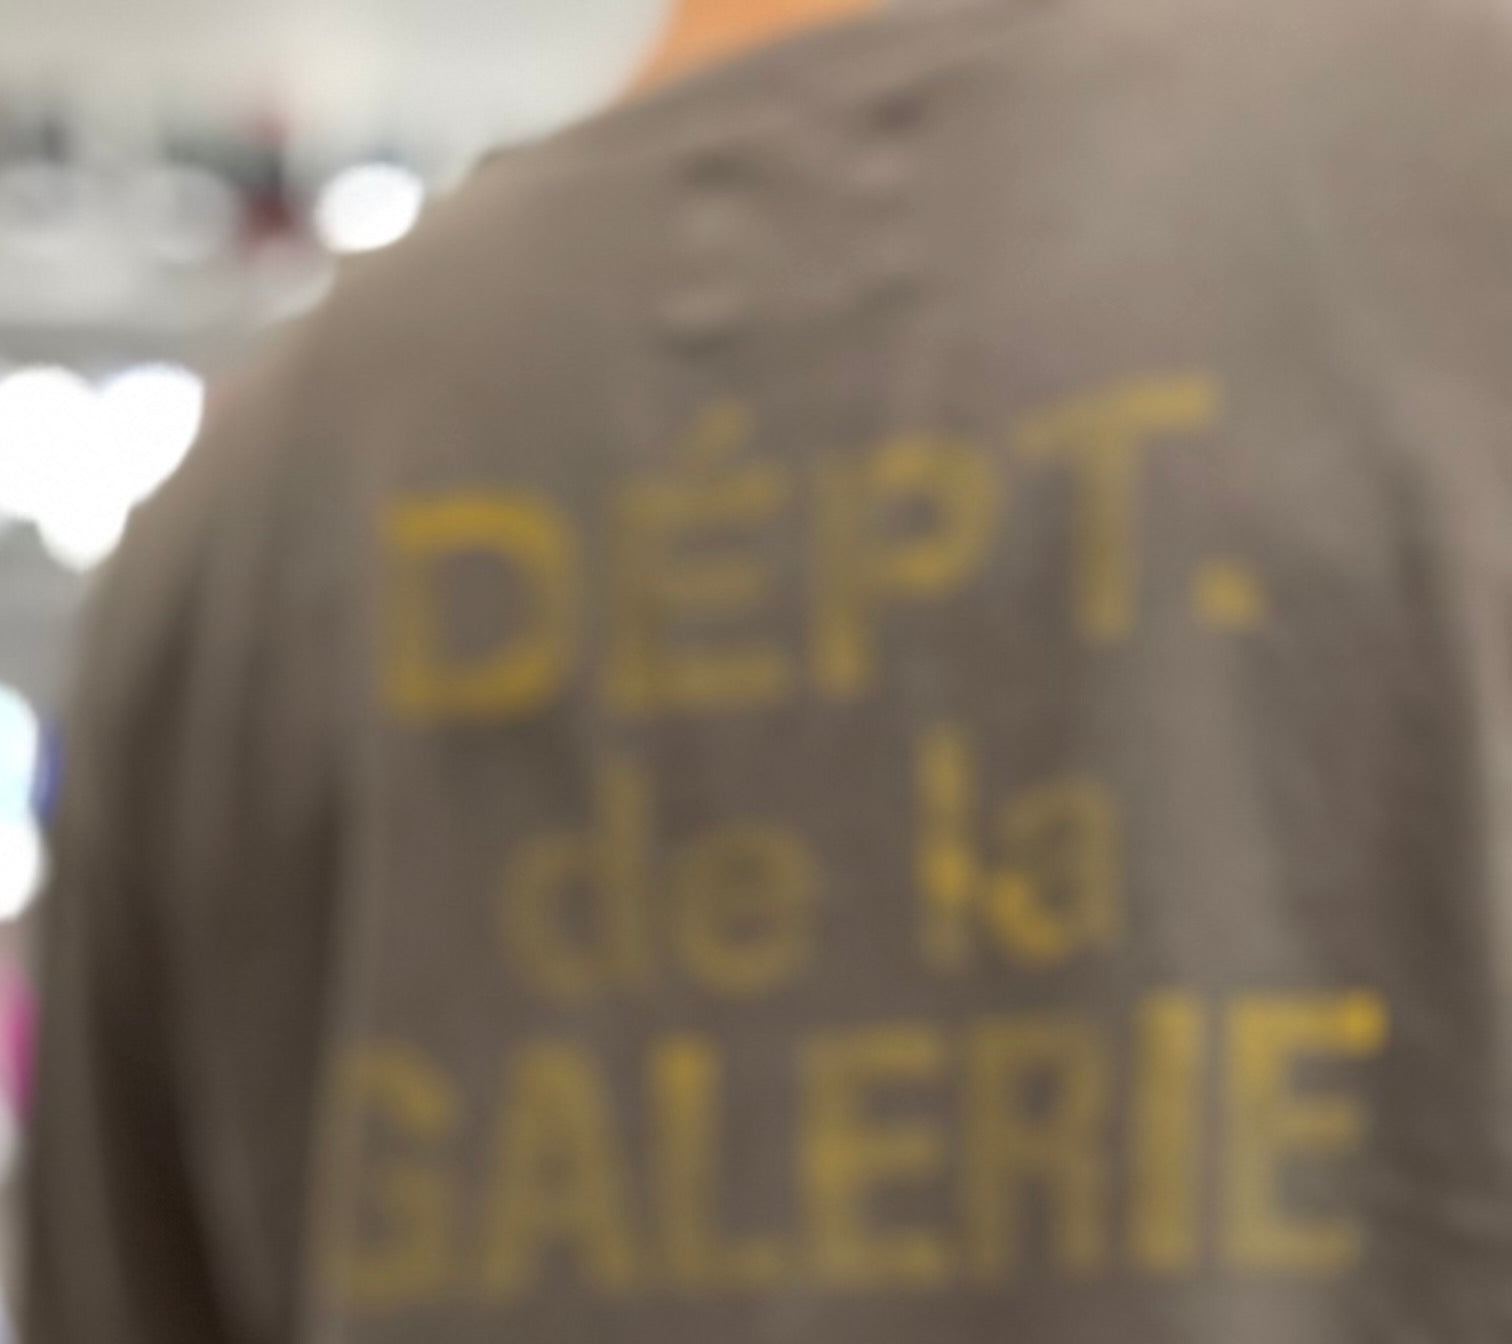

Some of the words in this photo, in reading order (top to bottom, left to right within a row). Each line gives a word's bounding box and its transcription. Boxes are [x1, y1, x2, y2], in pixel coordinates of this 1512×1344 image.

[380, 374, 1264, 724] DÉPT.
[501, 750, 820, 1000] de
[915, 722, 1122, 975] la
[332, 988, 1388, 1313] GALERIE
